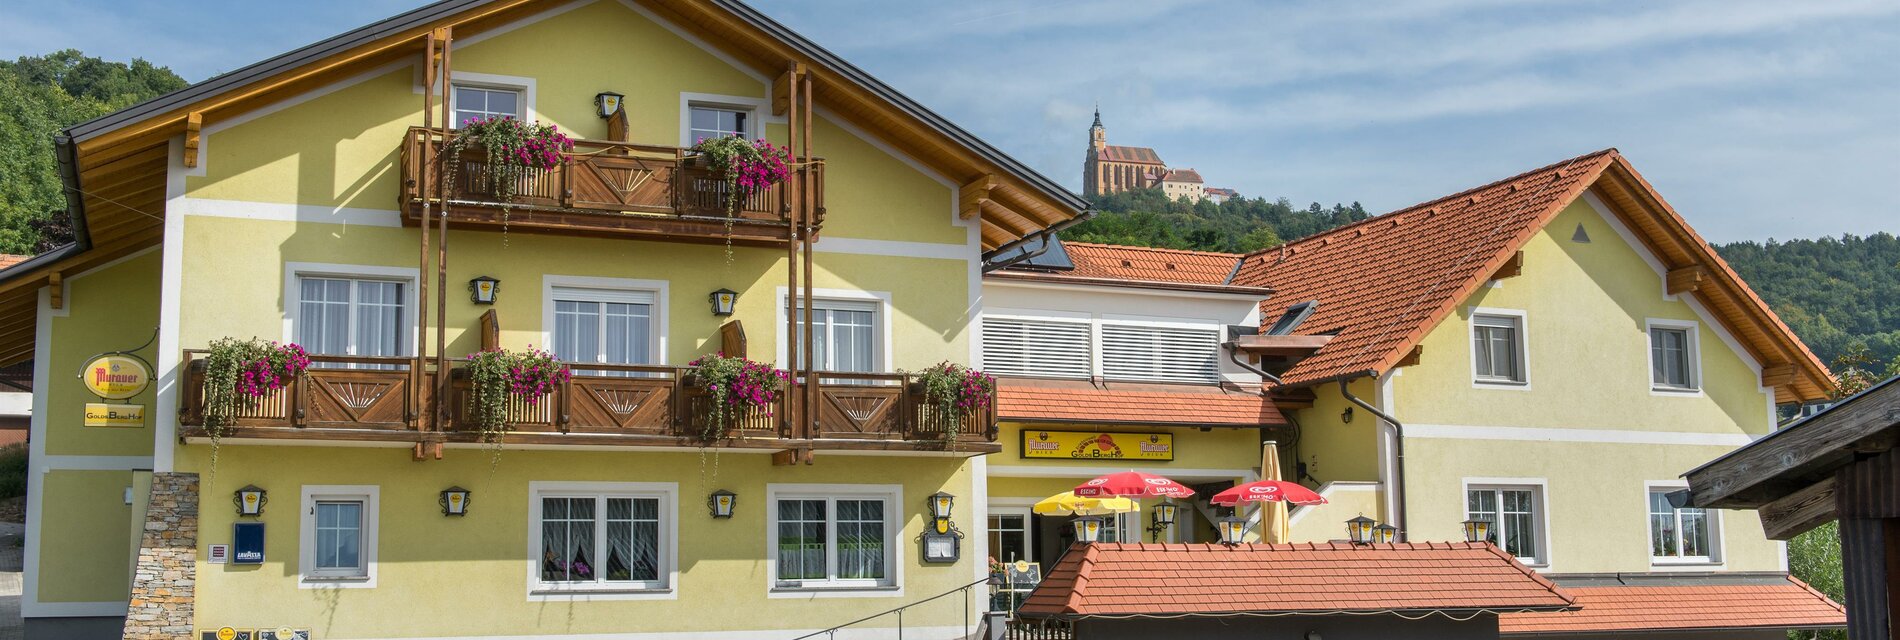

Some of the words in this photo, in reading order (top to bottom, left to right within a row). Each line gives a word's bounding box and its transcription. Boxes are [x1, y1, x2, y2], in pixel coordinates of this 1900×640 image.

[96, 367, 138, 386] Murauer
[1028, 438, 1060, 454] Murauer
[1140, 441, 1170, 456] Murauer
